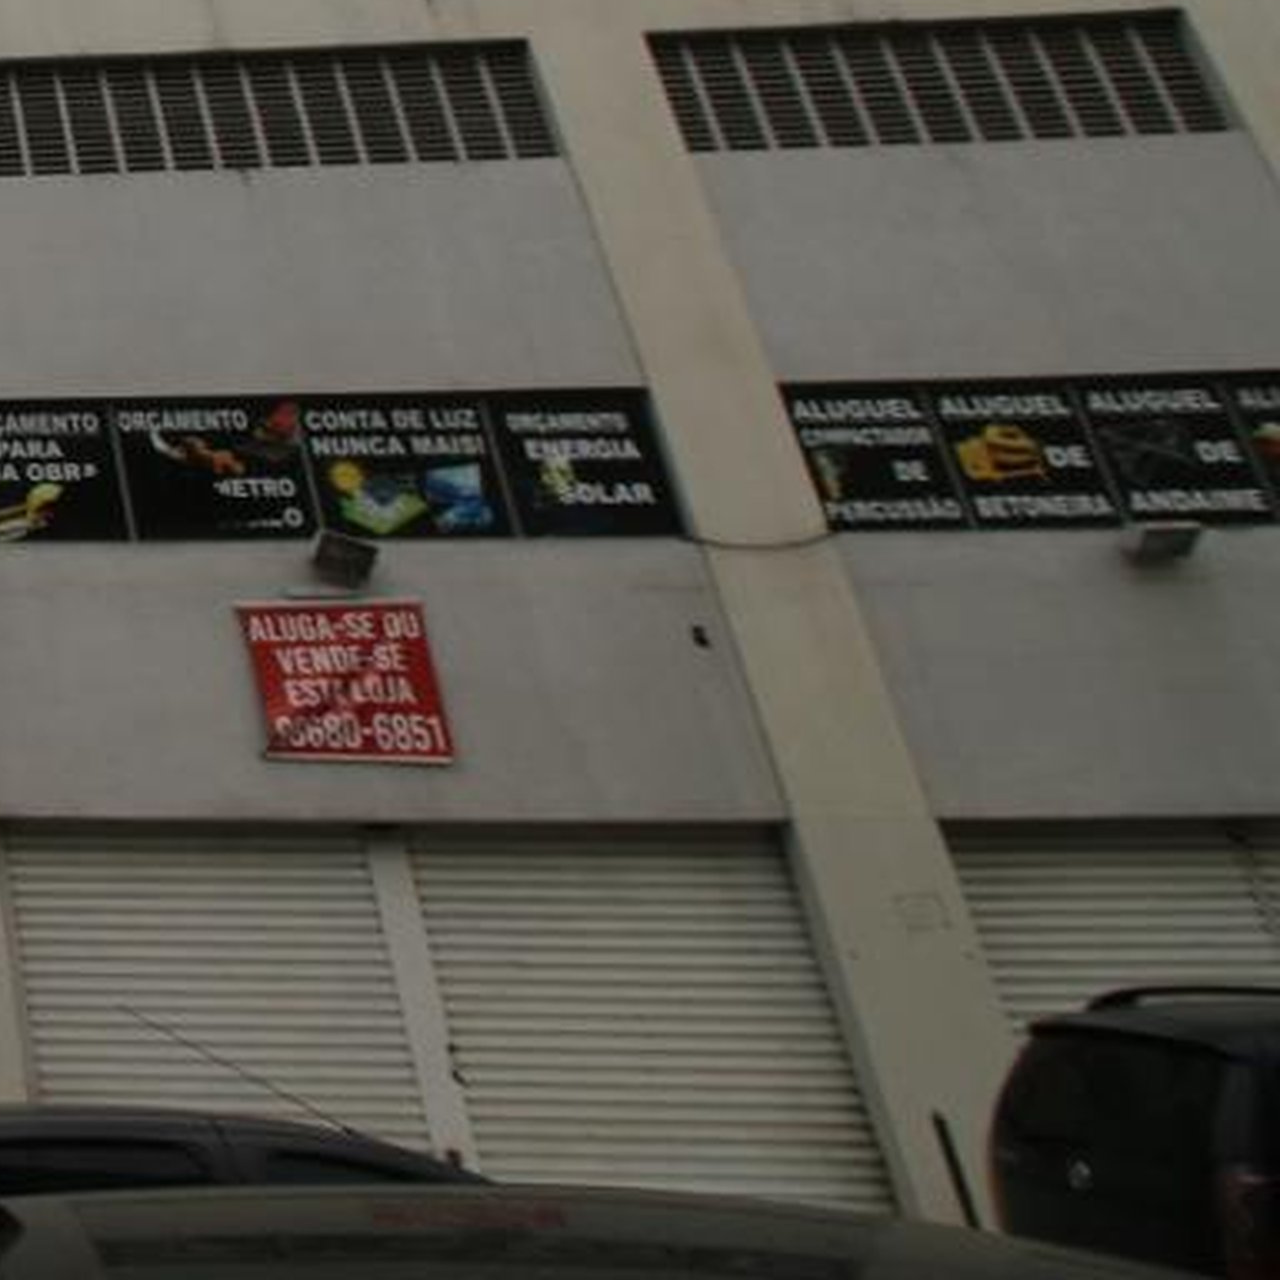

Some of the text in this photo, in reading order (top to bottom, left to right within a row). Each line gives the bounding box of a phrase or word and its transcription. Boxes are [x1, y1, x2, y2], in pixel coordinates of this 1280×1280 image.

[794, 398, 922, 419] ALUGUEL
[940, 394, 1070, 416] ALUGUEL
[1088, 389, 1222, 412] ALUGUEL
[304, 407, 480, 430] CONTA DE LUZ
[310, 434, 406, 455] NUNCA
[523, 438, 642, 459] ENERGIA
[1195, 440, 1244, 463] DE
[1044, 445, 1093, 468] DE
[892, 459, 929, 482] DE
[247, 610, 421, 642] ALUGA-SE OU
[350, 674, 418, 704] LOJA
